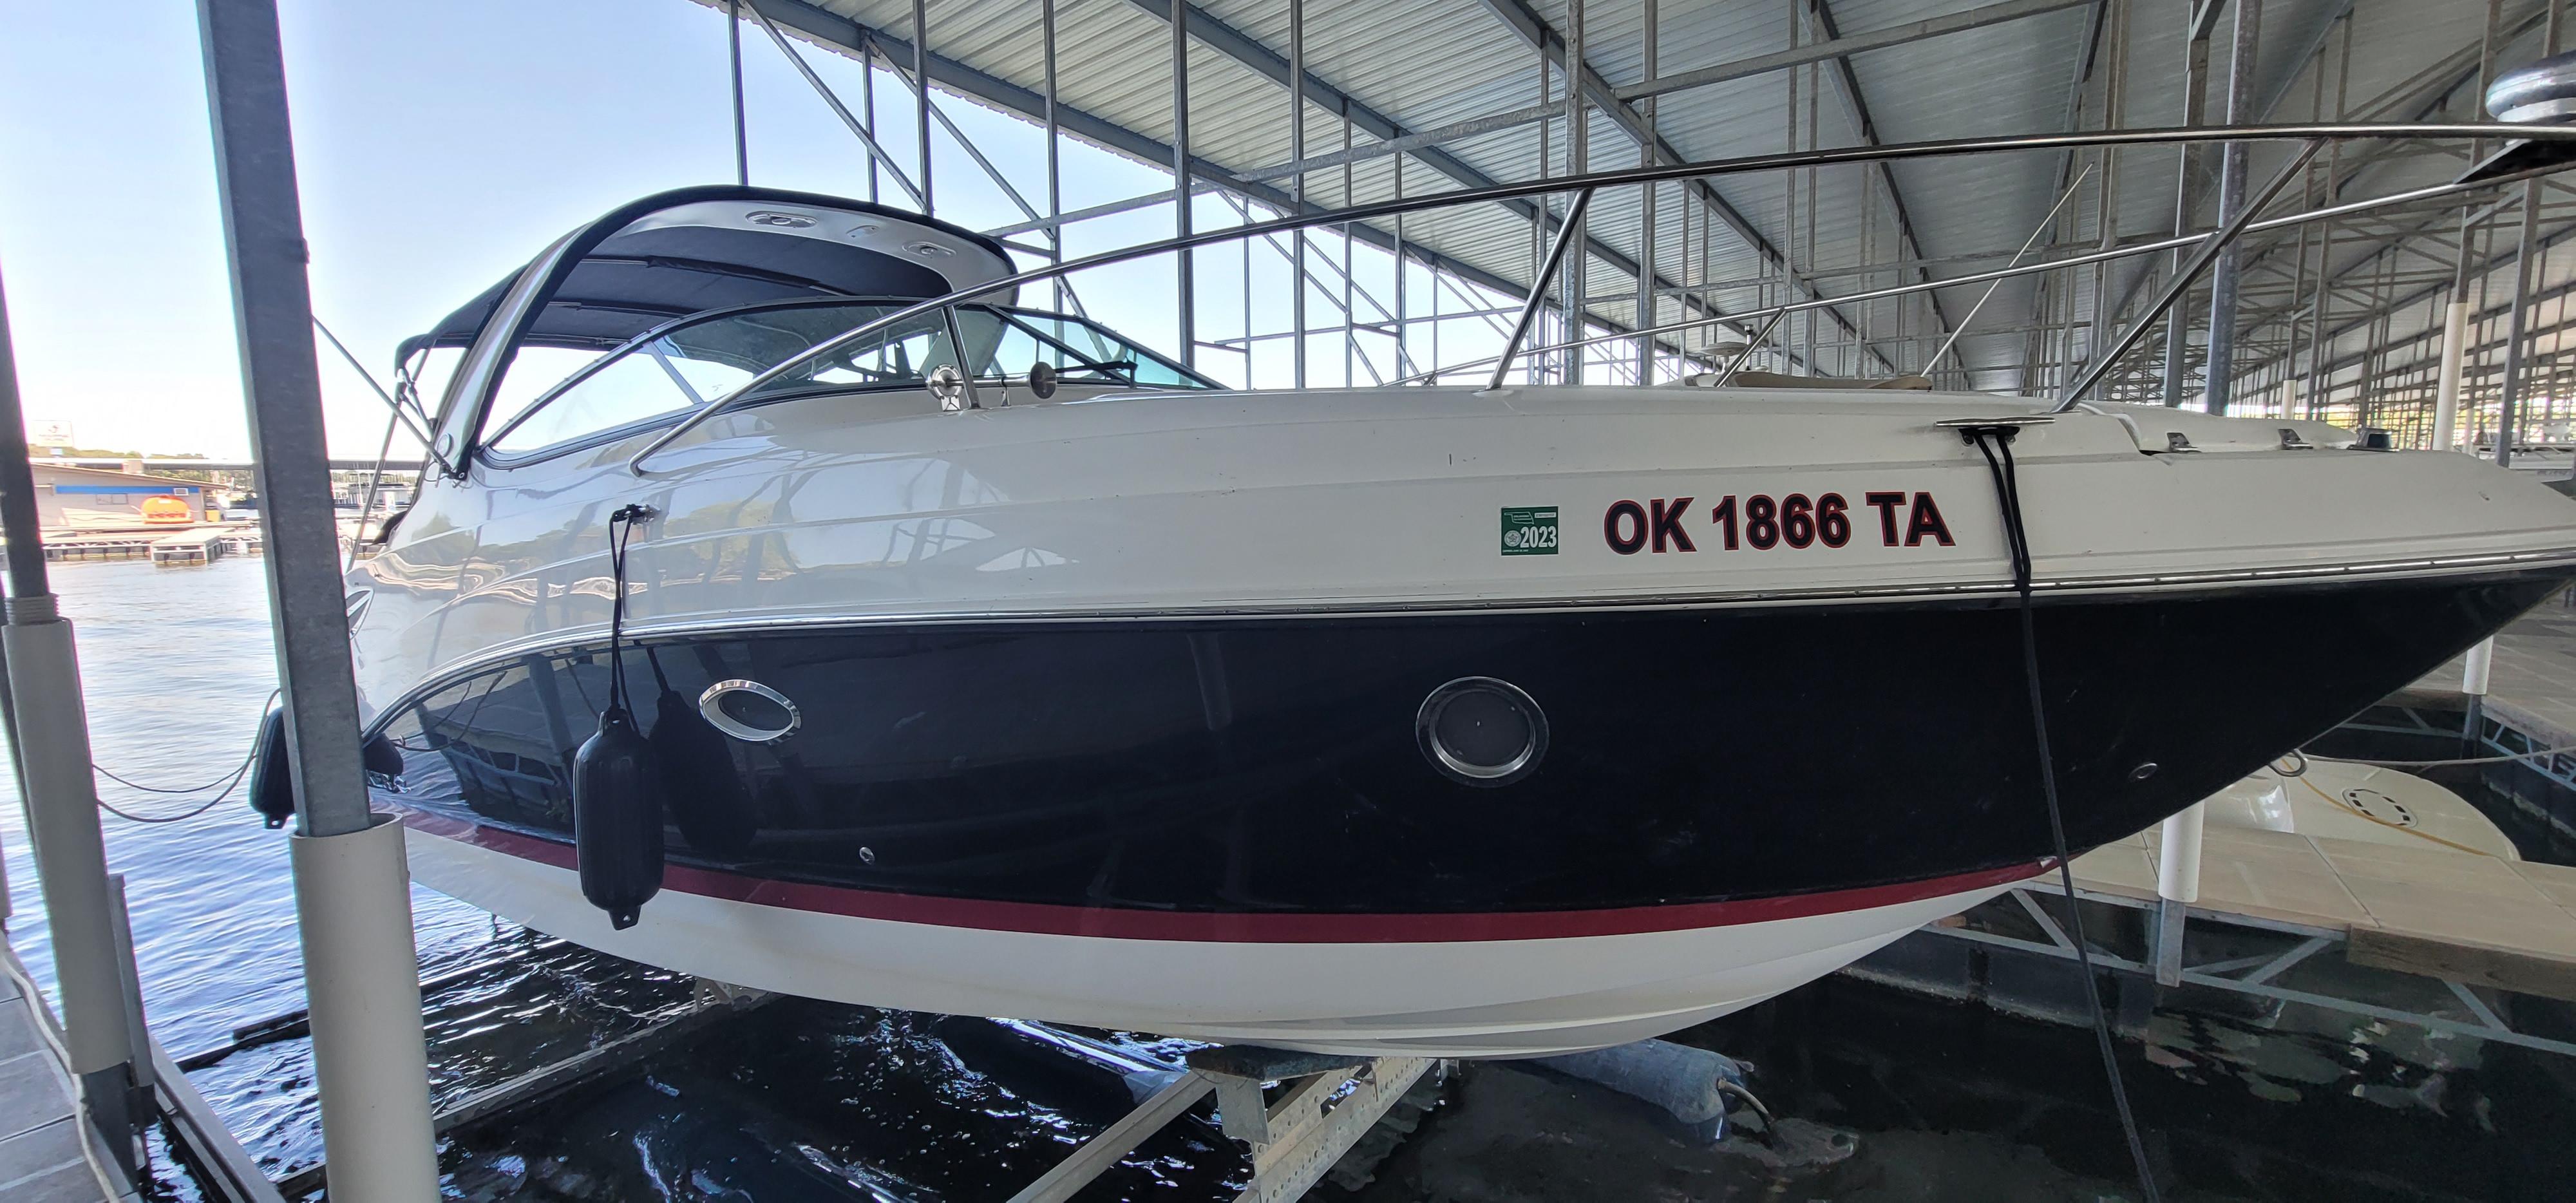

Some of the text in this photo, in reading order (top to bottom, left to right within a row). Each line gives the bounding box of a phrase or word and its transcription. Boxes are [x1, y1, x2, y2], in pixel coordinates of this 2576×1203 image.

[1520, 526, 1557, 548] 2023
[1604, 491, 1956, 555] OK 1866 TA
